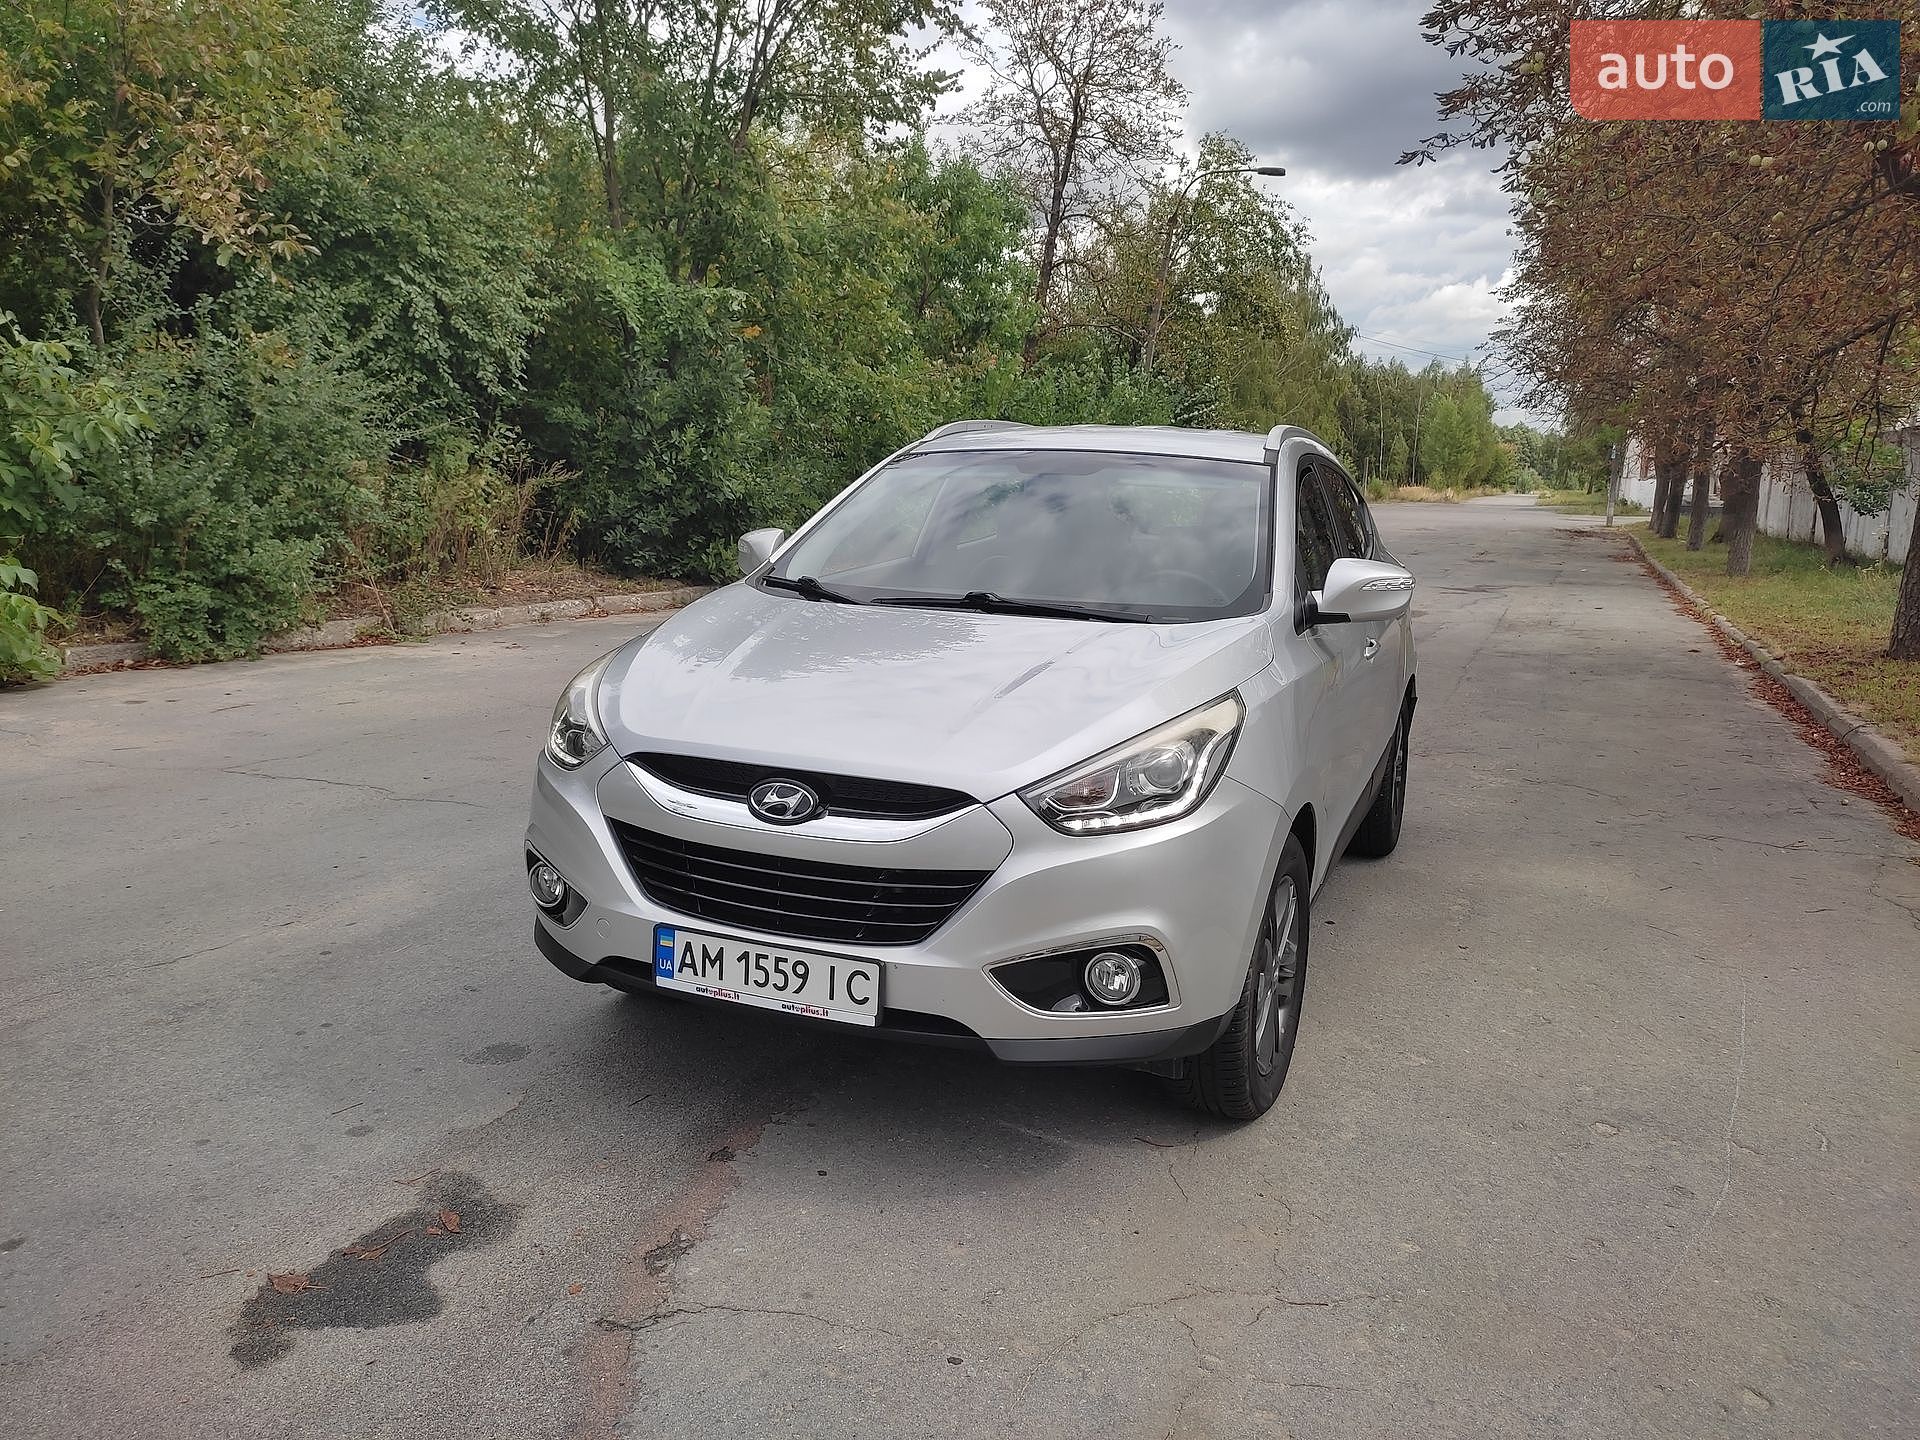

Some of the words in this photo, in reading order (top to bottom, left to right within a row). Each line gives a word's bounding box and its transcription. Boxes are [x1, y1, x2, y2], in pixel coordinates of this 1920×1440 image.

[659, 958, 672, 971] UA
[678, 941, 724, 980] AM
[736, 951, 810, 994] 1559
[829, 965, 871, 1005] IC
